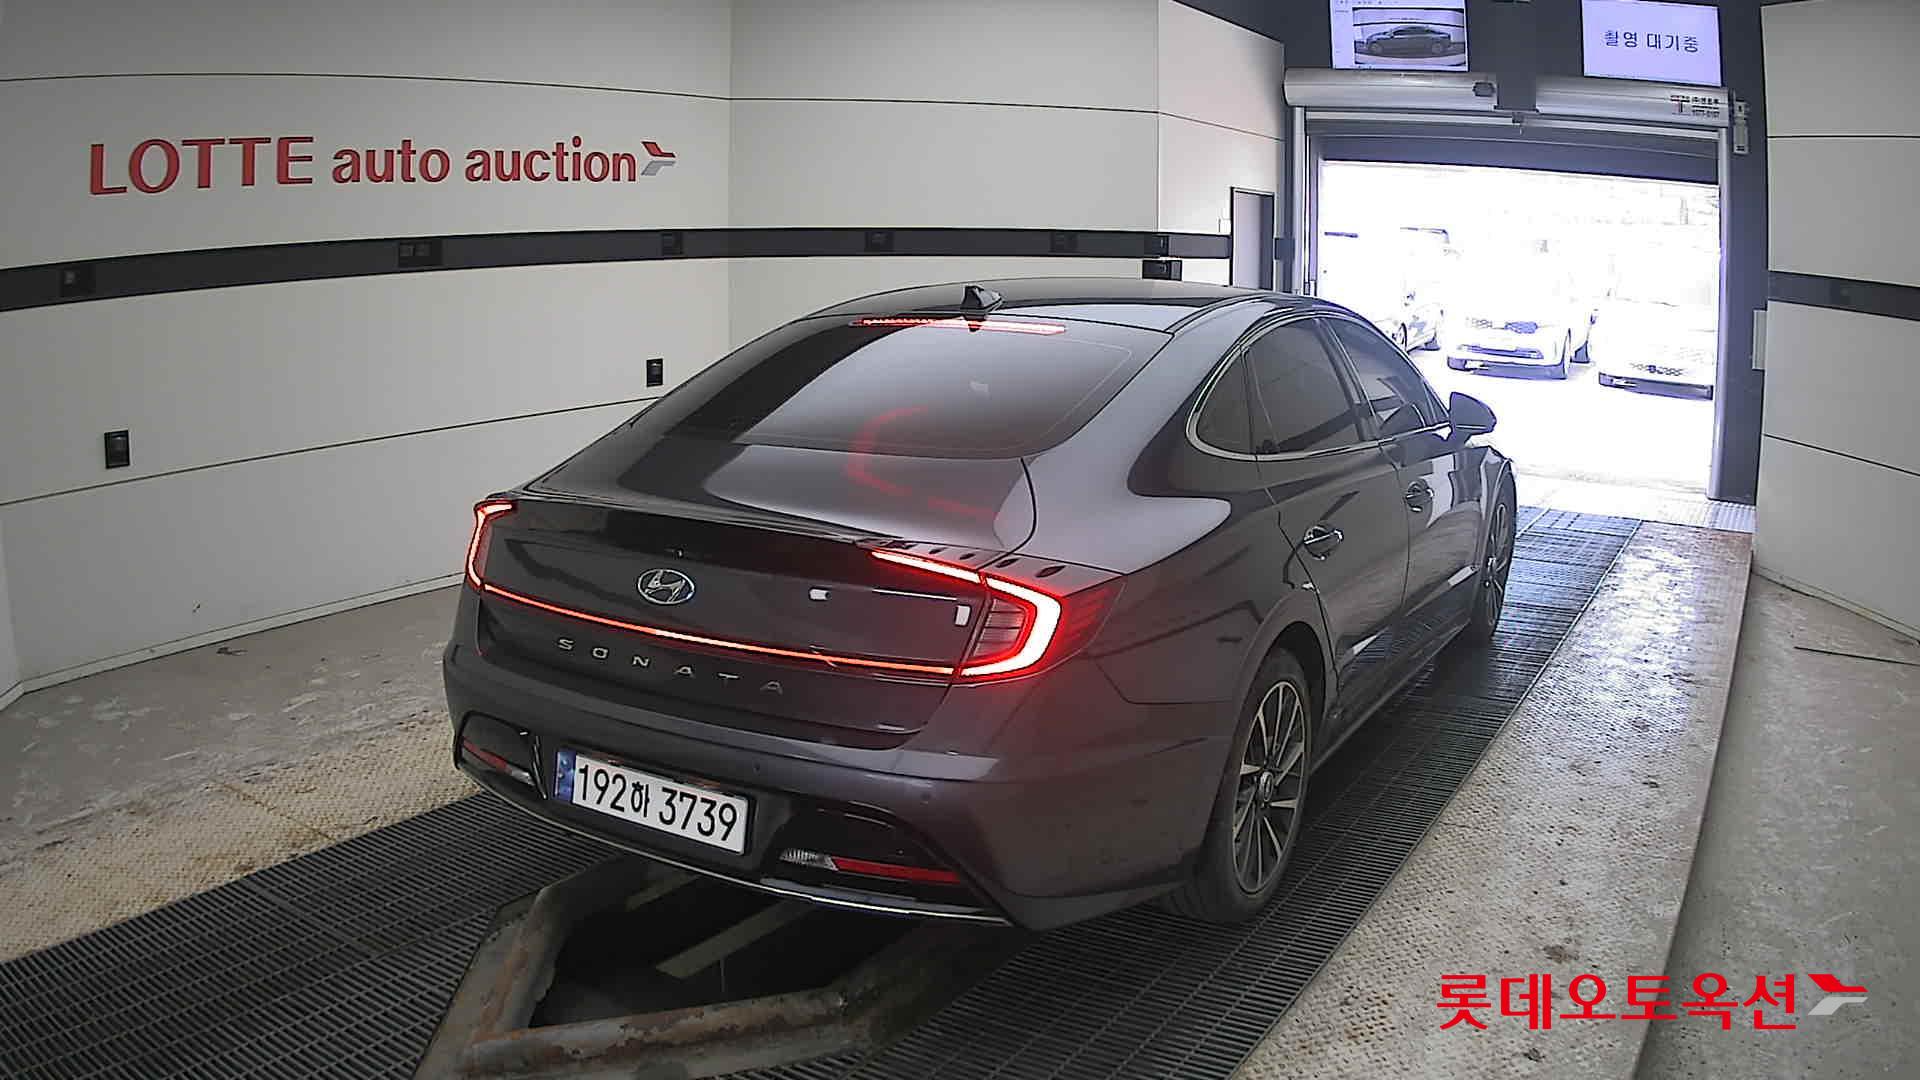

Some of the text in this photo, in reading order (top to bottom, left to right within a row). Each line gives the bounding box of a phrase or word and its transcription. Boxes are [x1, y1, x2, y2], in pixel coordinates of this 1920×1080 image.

[1646, 33, 1698, 53] 대기중
[90, 135, 637, 195] LOTTE auto auction
[557, 638, 783, 694] SONATA
[578, 764, 738, 841] 192하 3739
